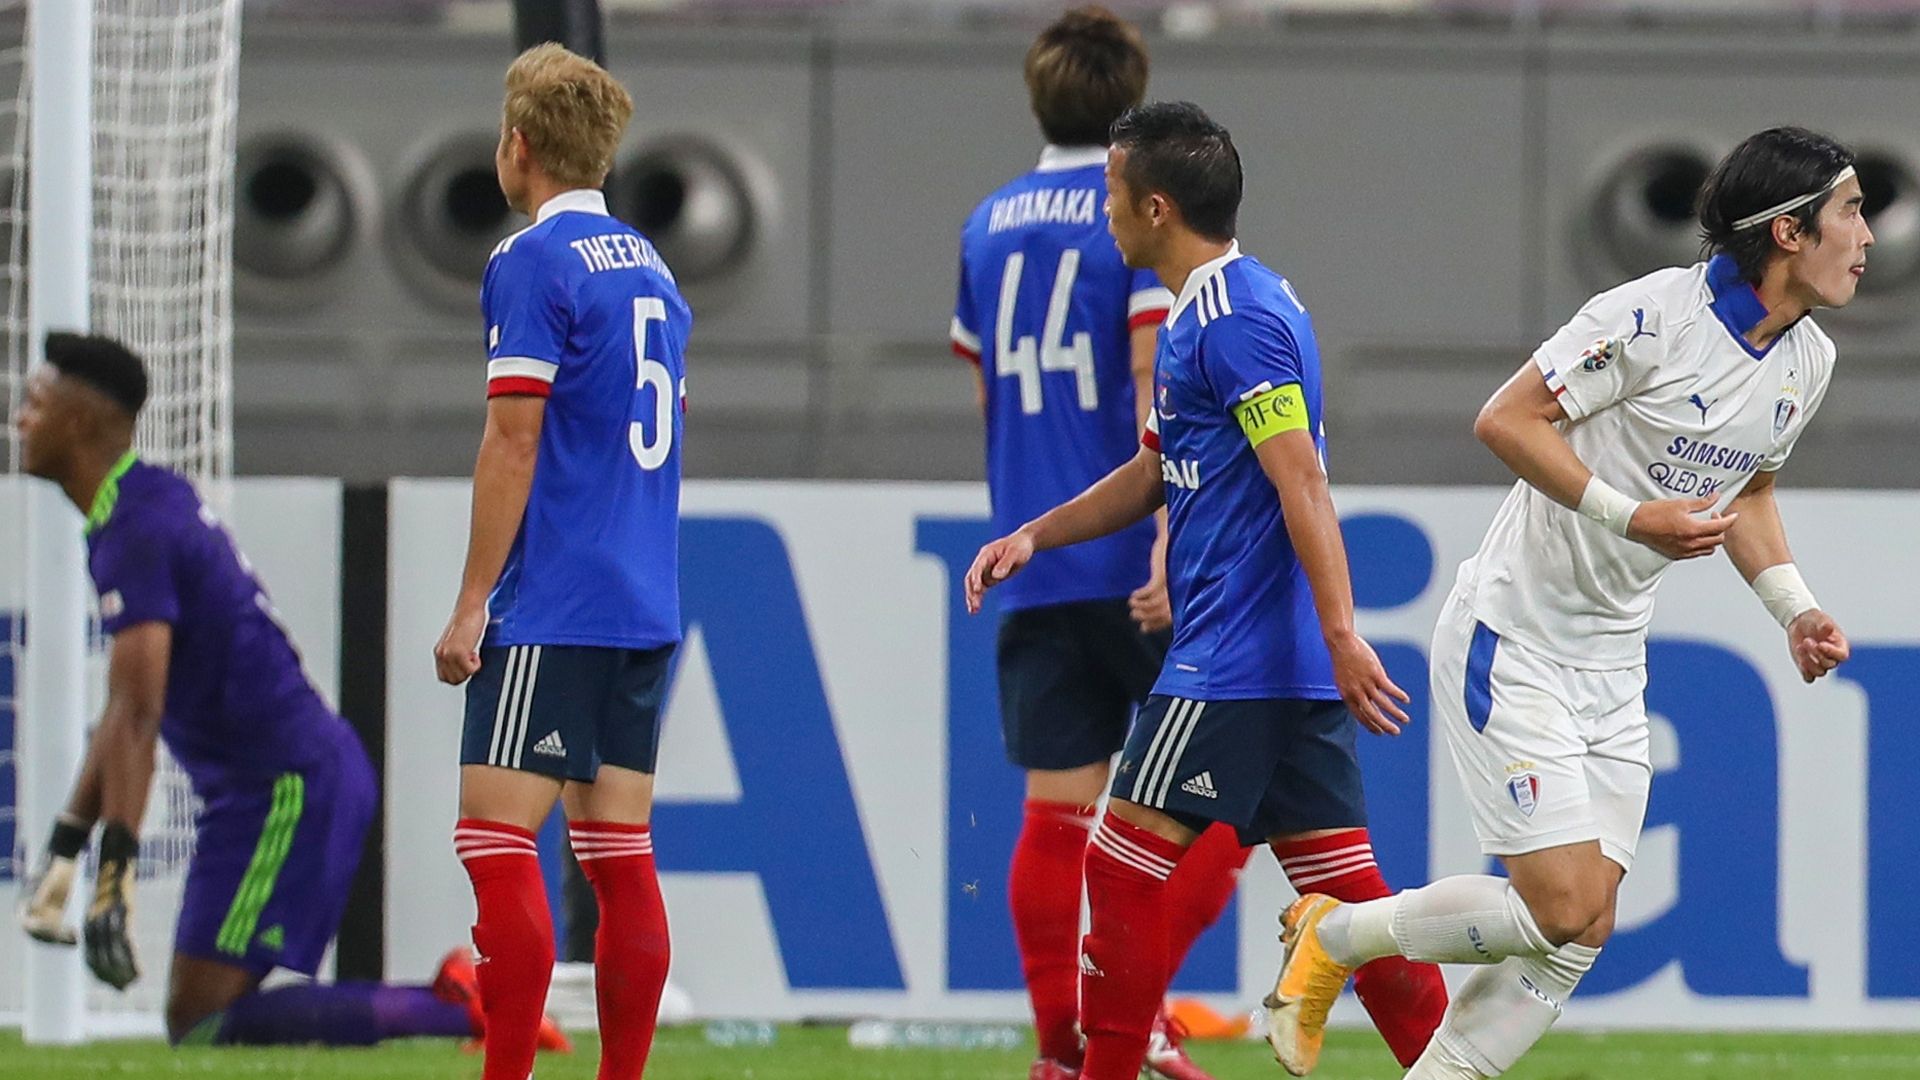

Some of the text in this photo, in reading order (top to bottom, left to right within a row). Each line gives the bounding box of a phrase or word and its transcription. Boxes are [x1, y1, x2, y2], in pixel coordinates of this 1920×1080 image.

[996, 248, 1098, 414] 44
[629, 296, 673, 471] 5
[1666, 435, 1765, 473] SAMSUNG
[1648, 461, 1725, 498] QLED 8K
[1181, 782, 1219, 799] adidas
